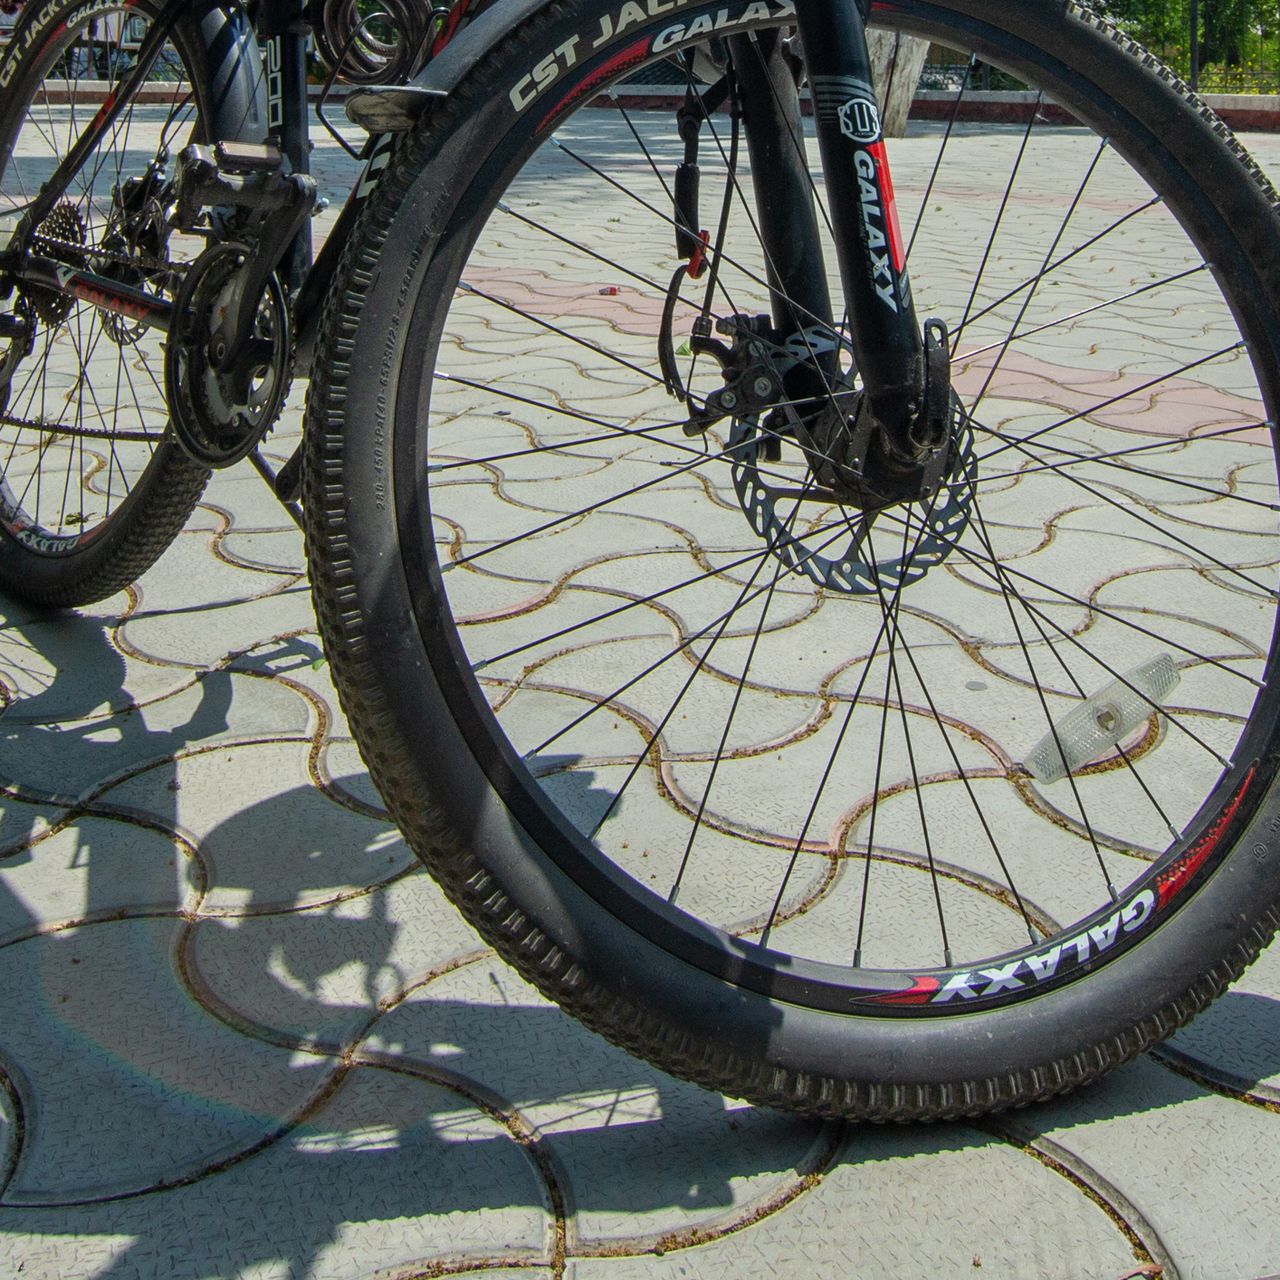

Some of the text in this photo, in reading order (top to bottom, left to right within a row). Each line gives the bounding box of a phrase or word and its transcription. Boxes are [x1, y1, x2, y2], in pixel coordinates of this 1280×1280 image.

[0, 43, 22, 88] CST
[508, 34, 580, 112] CST
[852, 149, 899, 314] GALAXY
[930, 889, 1155, 1003] GALAXY
